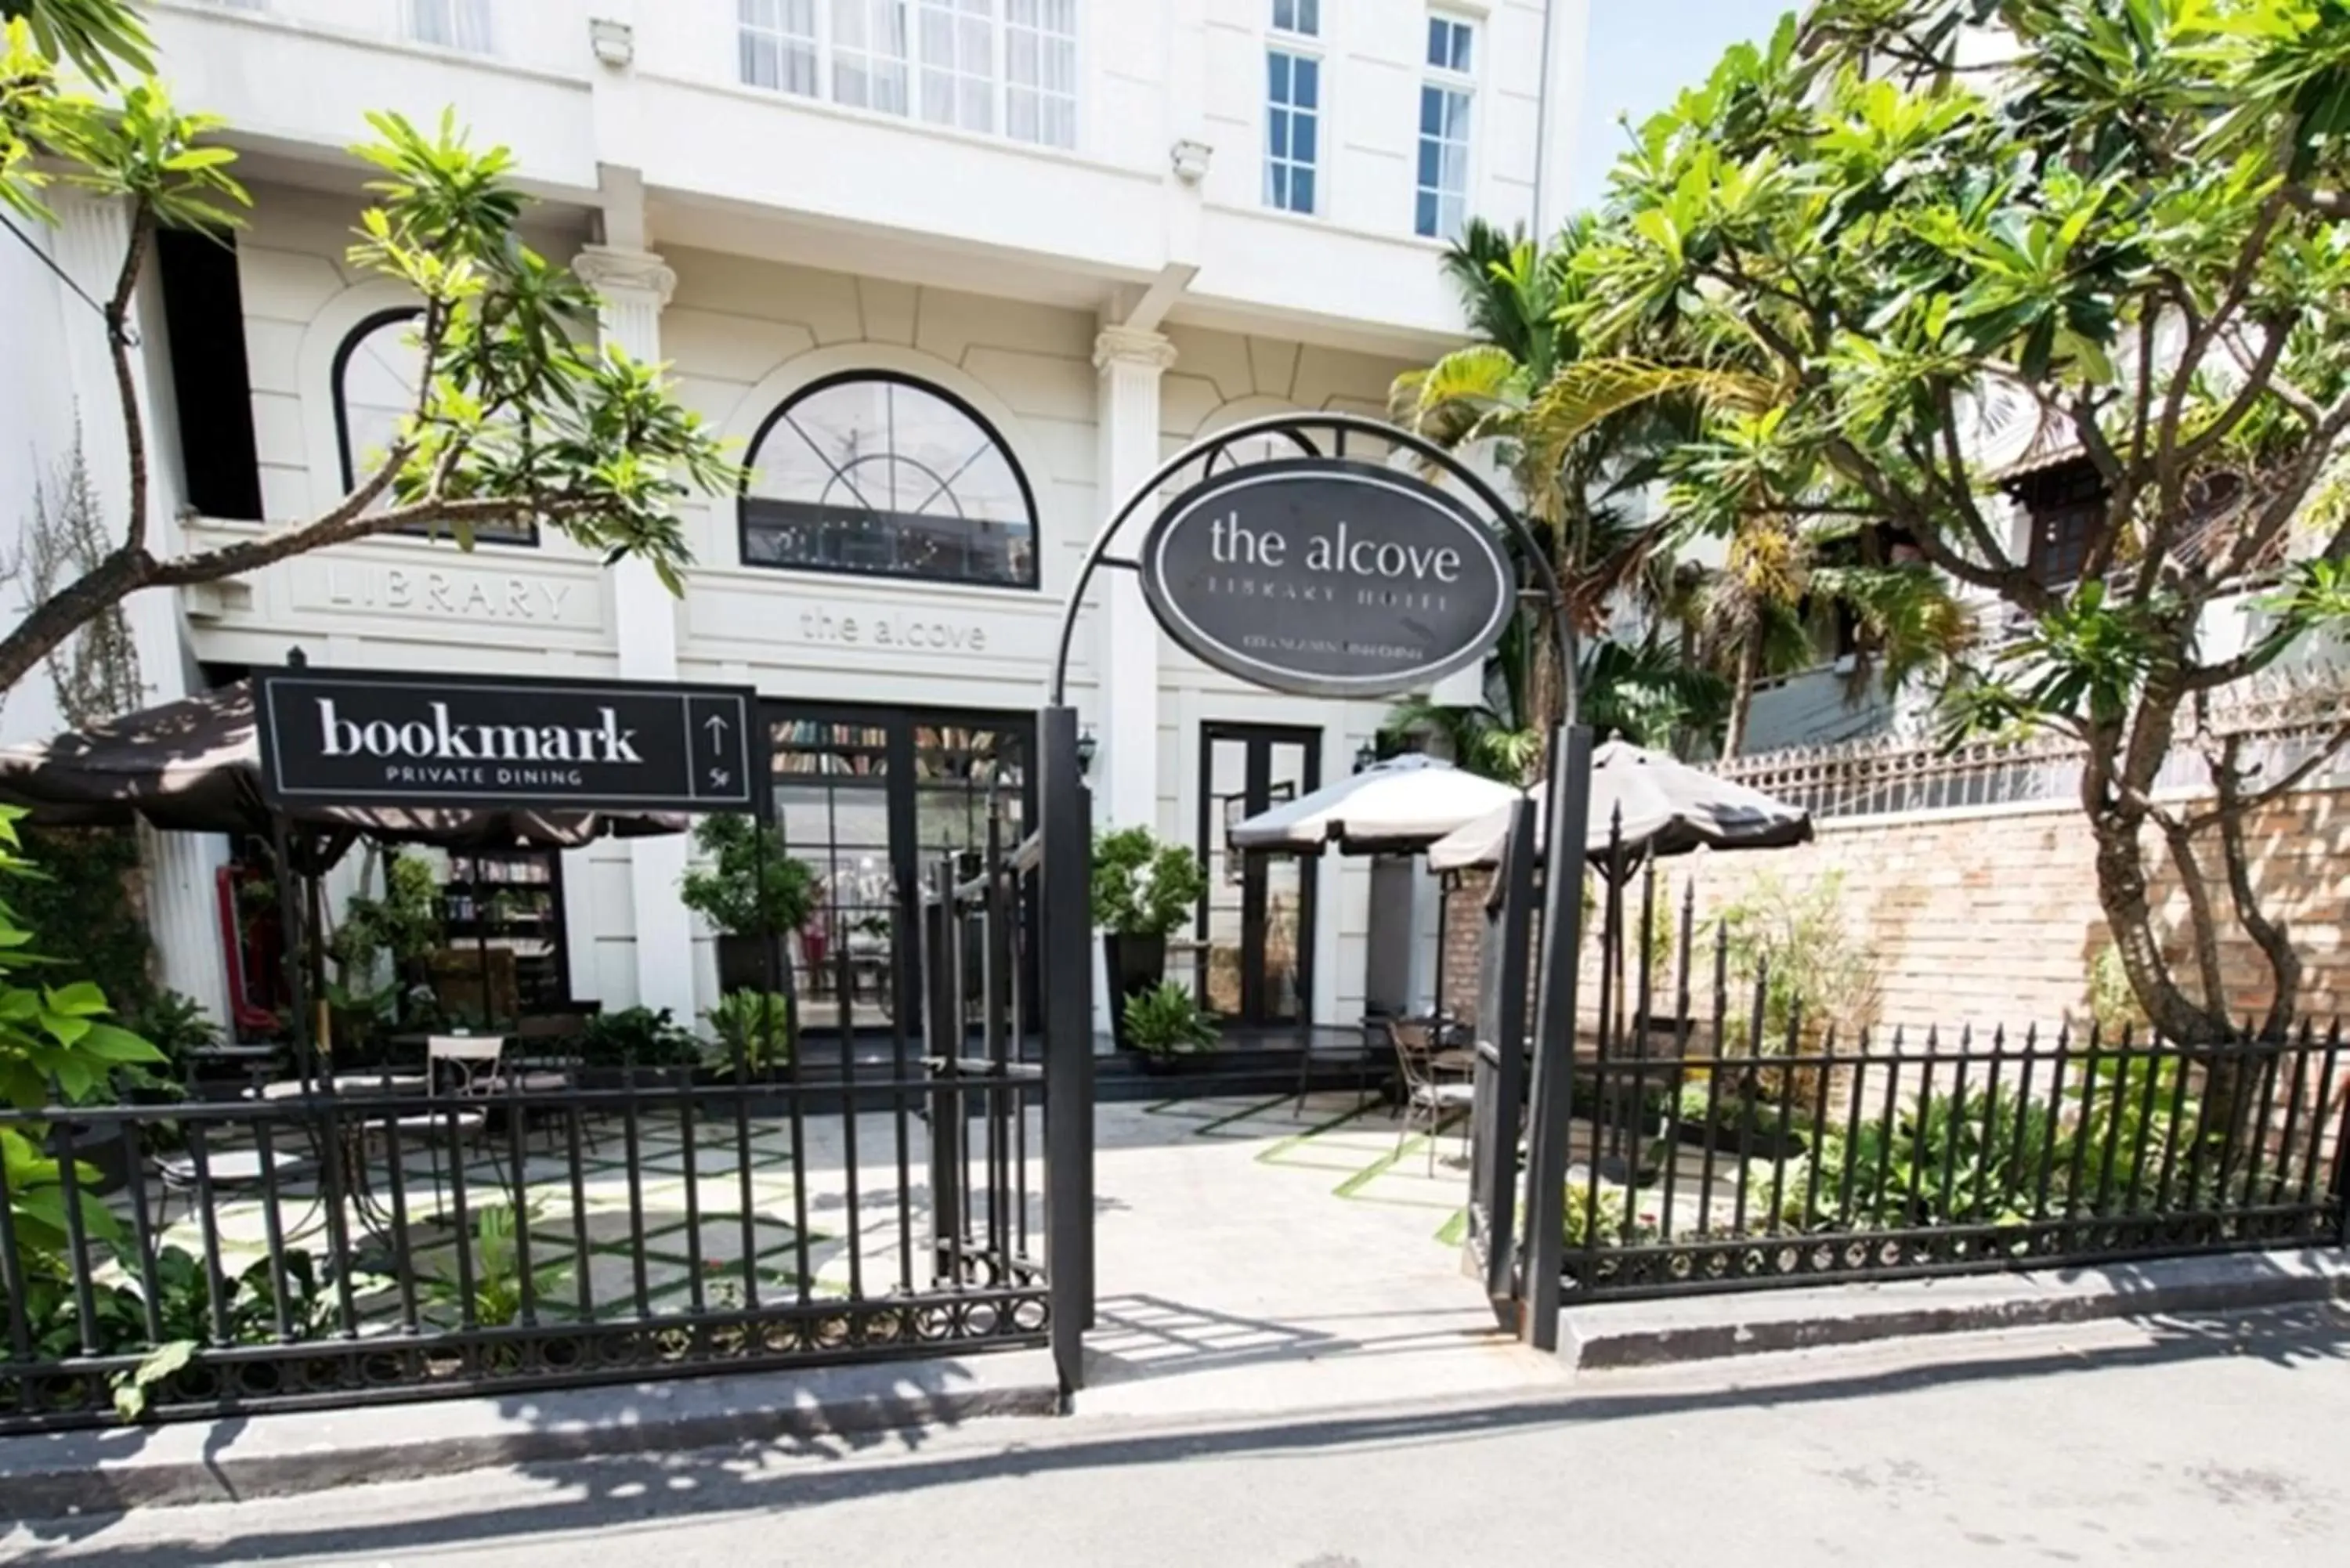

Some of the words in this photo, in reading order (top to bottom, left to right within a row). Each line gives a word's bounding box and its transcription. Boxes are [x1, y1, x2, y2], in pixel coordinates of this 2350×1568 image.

[1209, 511, 1286, 567] the
[1306, 521, 1461, 582] alcove
[327, 563, 571, 620] LIBRARY
[799, 605, 859, 643] the
[873, 611, 987, 652] alcove
[316, 697, 643, 763] bookmark
[385, 765, 484, 784] PRIVATE
[497, 767, 583, 786] DINING
